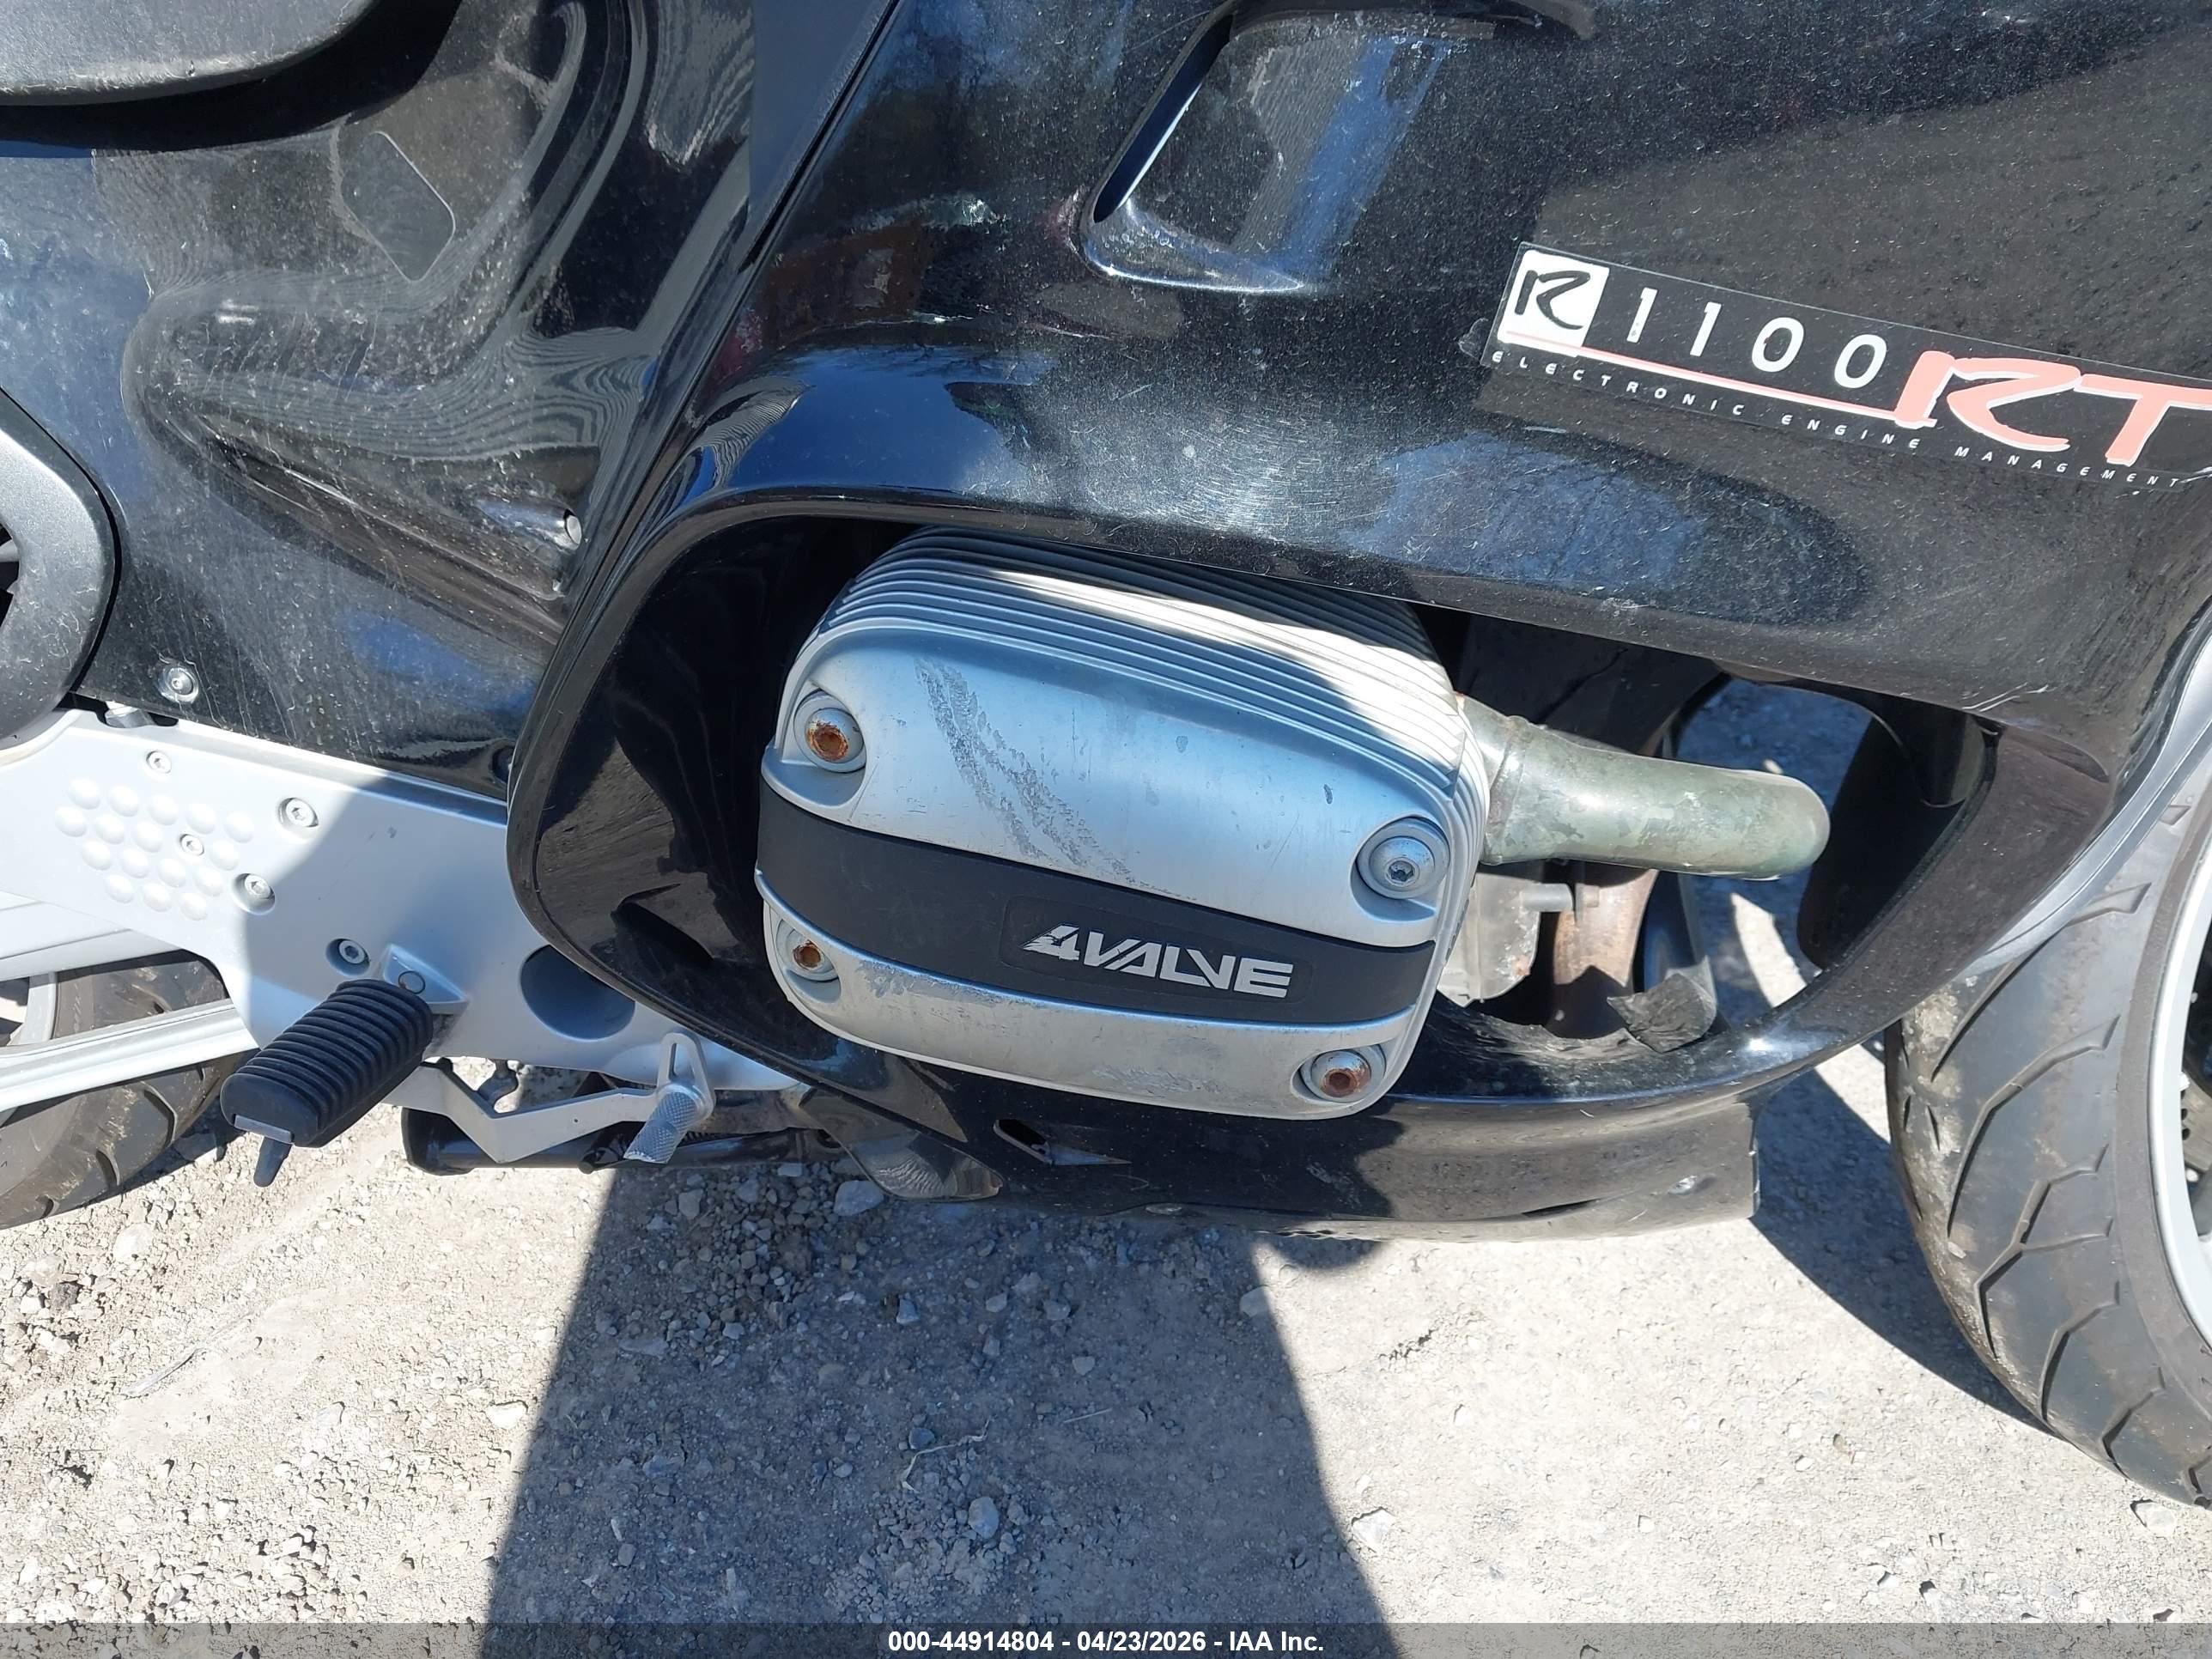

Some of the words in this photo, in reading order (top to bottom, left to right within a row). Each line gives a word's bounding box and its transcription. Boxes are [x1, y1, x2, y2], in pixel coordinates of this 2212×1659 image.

[1627, 288, 1887, 389] 1100
[1492, 350, 1744, 416] ELECTRONIC
[1781, 414, 1921, 450] ENGINE
[1954, 446, 2183, 489] MANAGEMENT
